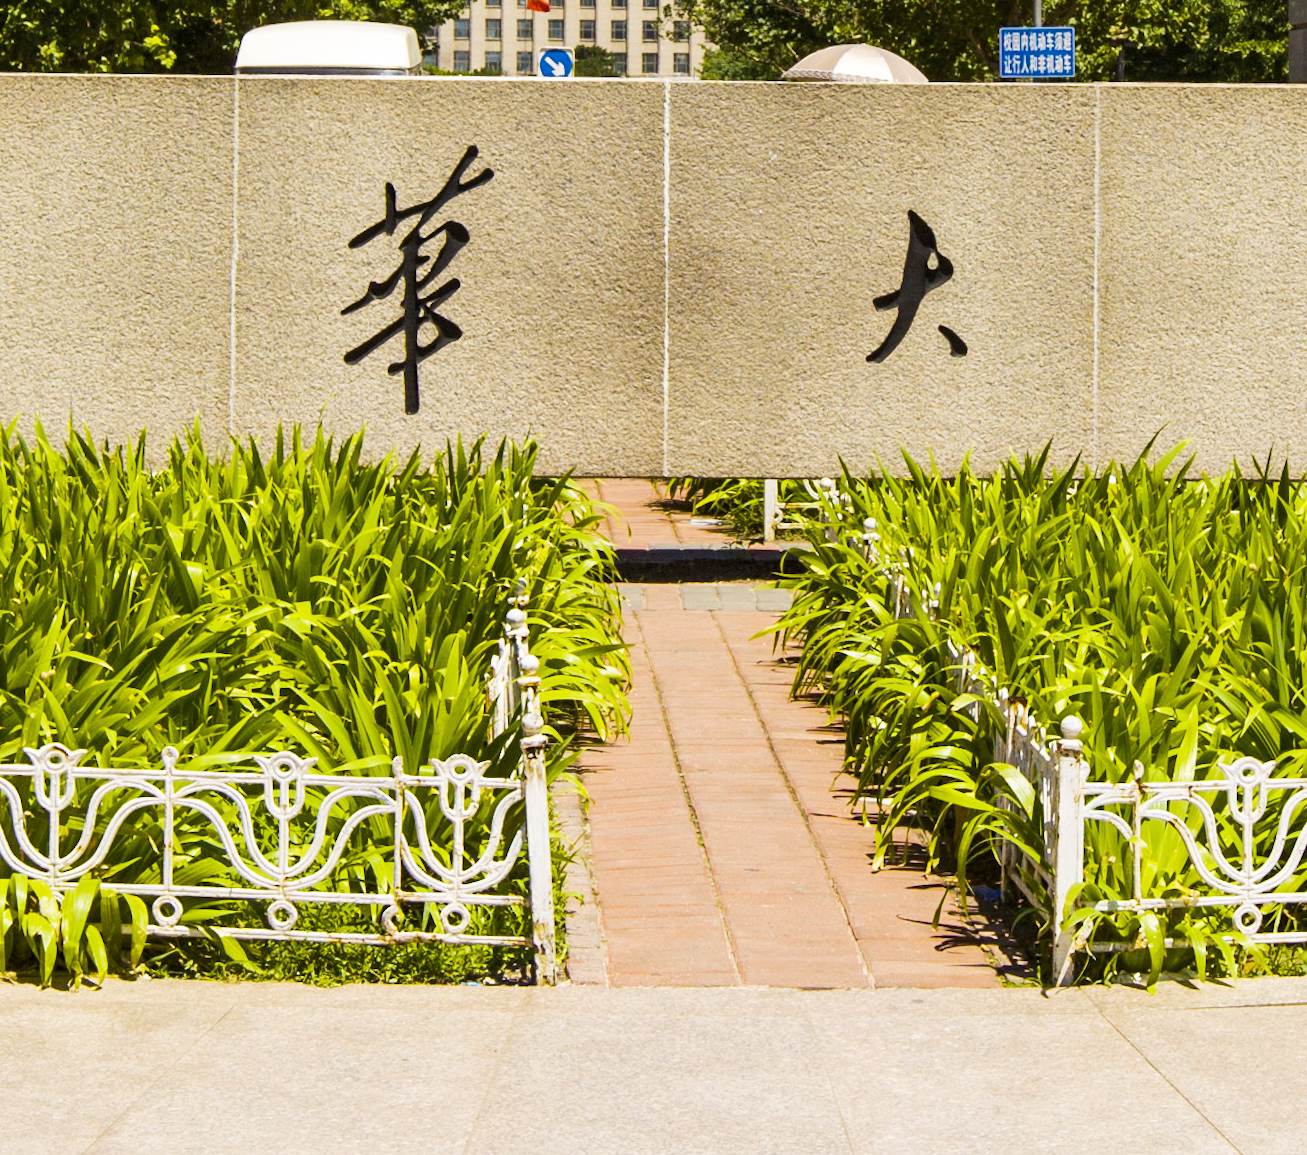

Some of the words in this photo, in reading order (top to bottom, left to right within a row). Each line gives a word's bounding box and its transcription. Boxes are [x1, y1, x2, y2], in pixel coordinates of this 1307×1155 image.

[1003, 31, 1072, 51] 校园内机动车须避
[1003, 54, 1072, 74] 让行人和非机动车
